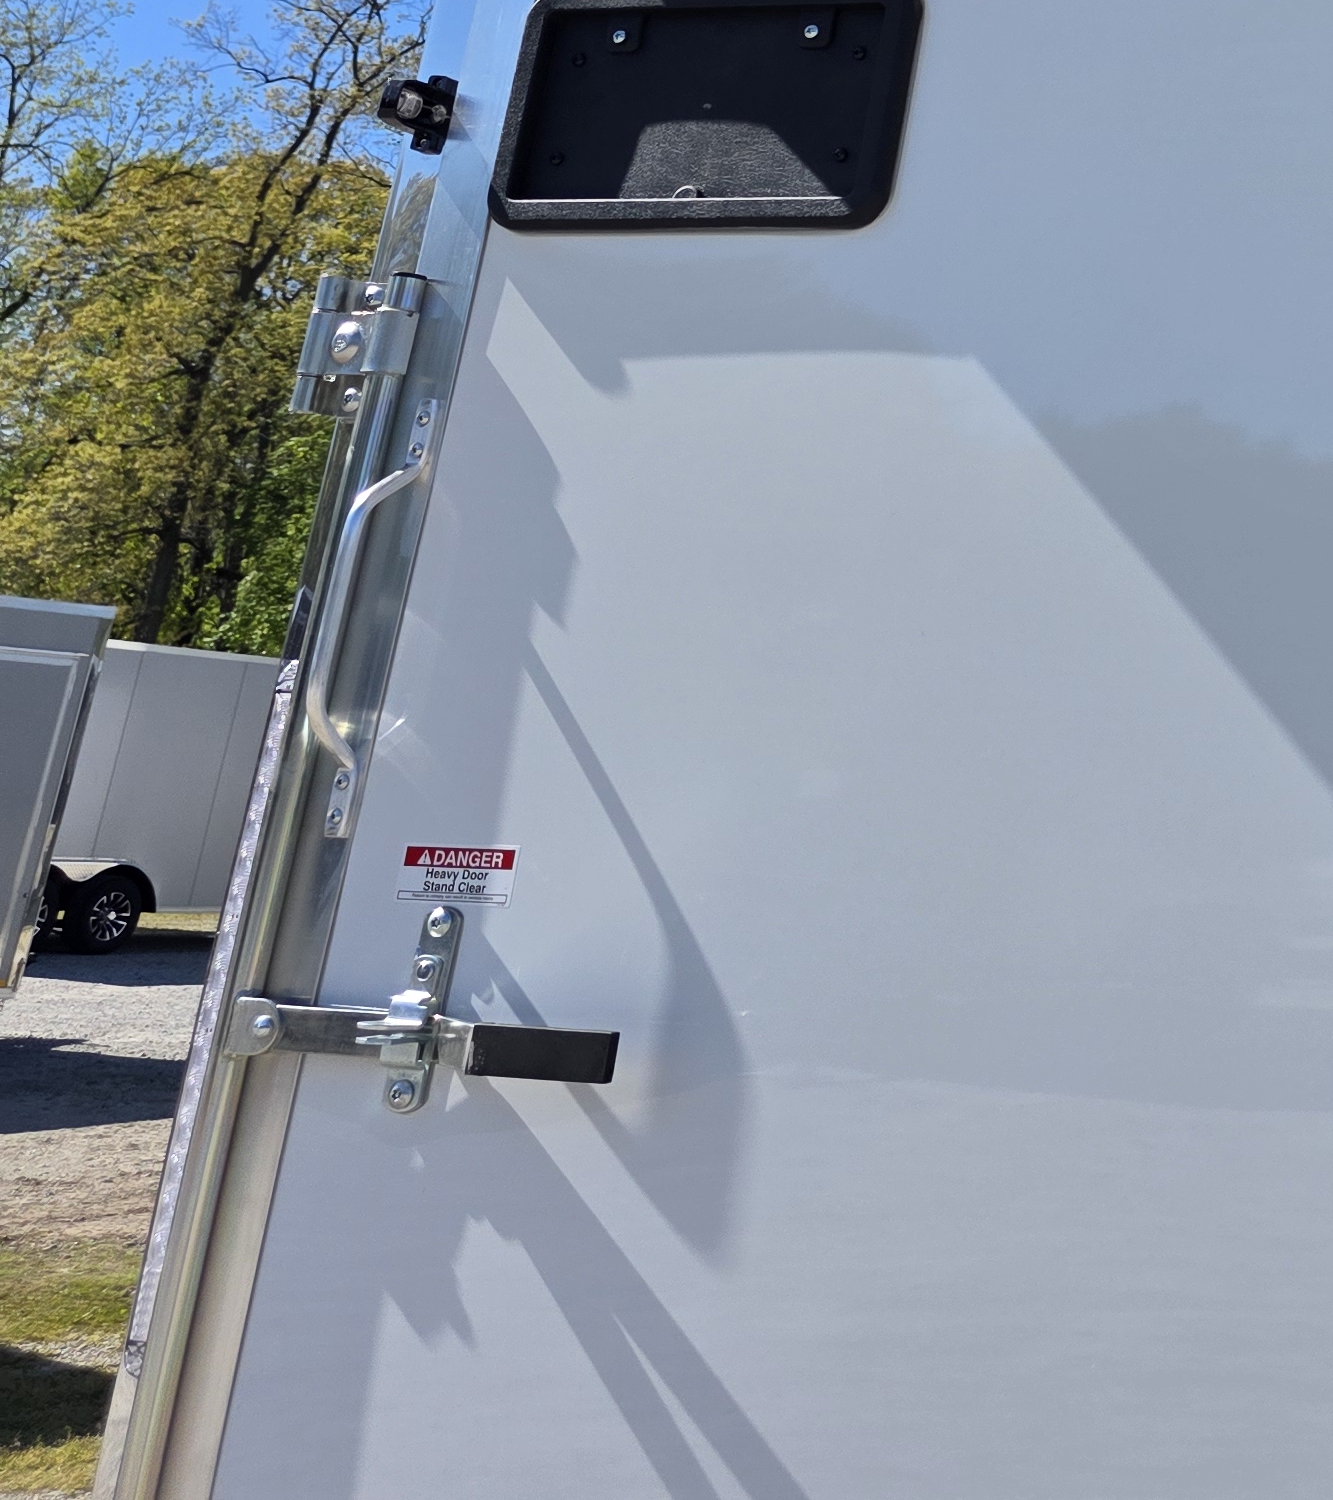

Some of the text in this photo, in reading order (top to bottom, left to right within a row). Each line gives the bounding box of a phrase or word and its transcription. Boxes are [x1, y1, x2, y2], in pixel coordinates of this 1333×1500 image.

[433, 850, 504, 868] DANGER
[425, 868, 489, 883] Heavy Door
[423, 881, 486, 893] Stand Clear
